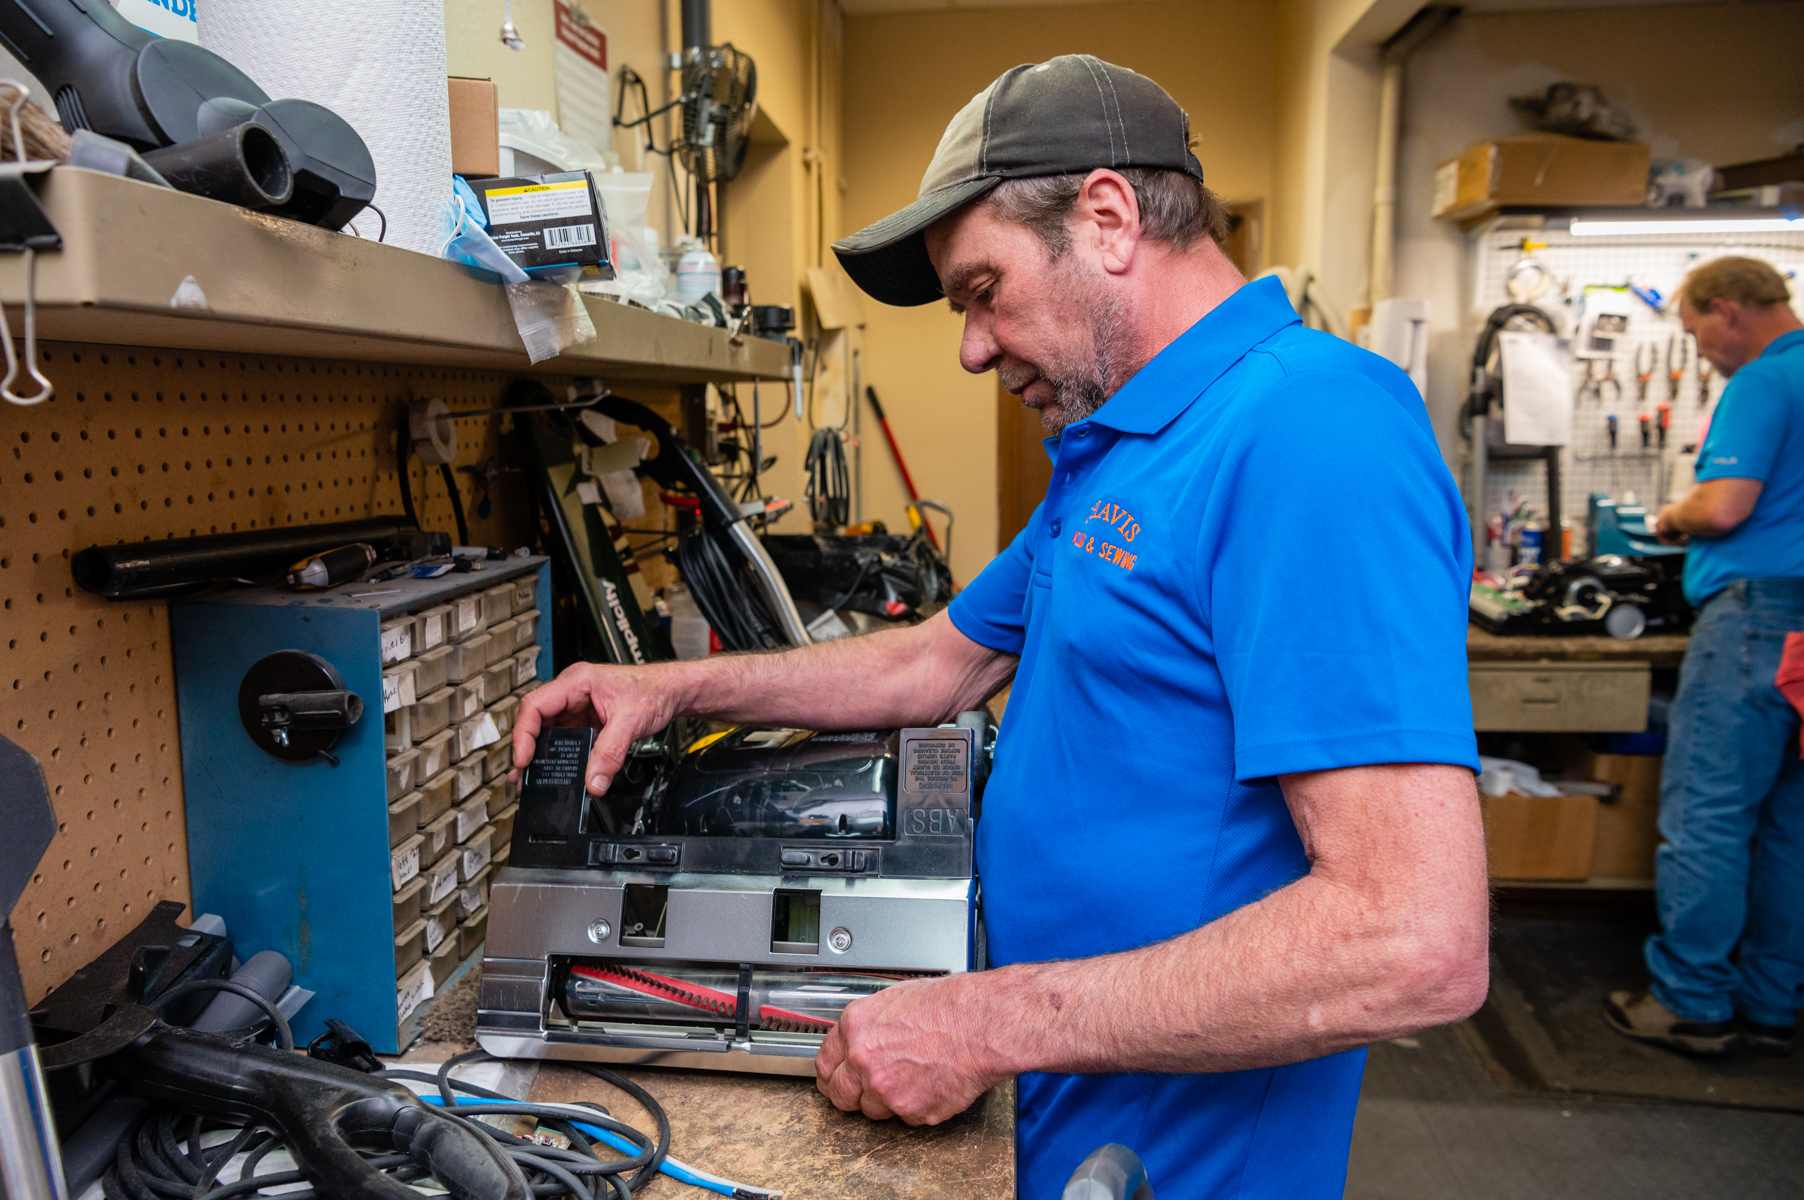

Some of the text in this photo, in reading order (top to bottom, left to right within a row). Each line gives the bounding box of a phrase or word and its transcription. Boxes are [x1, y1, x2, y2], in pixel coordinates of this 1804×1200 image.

[1085, 536, 1094, 553] &
[1098, 542, 1138, 570] SEWING
[602, 580, 644, 665] mplicity
[912, 808, 958, 834] ABS
